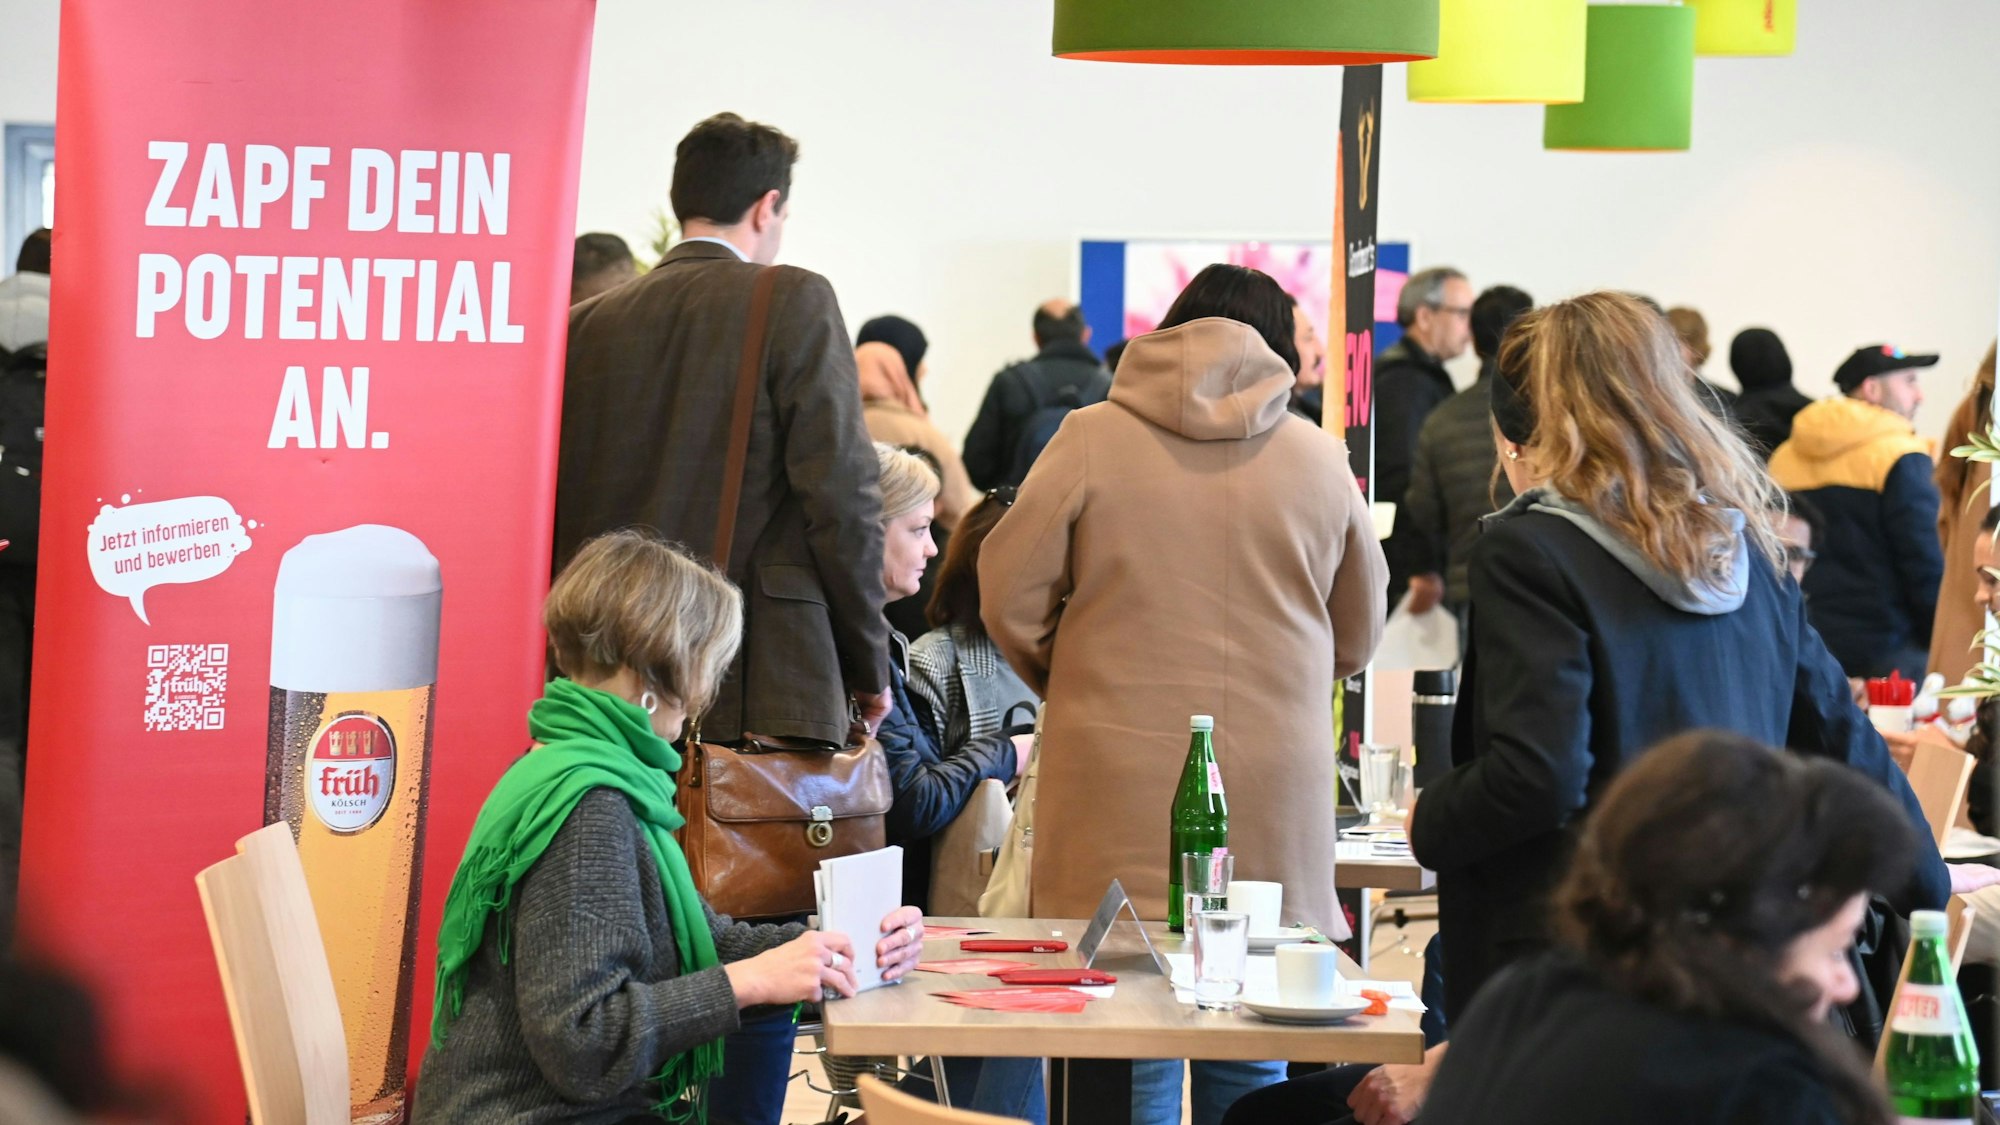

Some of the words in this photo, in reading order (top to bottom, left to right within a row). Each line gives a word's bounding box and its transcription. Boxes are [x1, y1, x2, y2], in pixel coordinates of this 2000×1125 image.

[145, 141, 331, 230] ZAPF
[348, 148, 511, 235] DEIN
[136, 253, 524, 343] POTENTIAL
[267, 366, 390, 448] AN.
[100, 530, 137, 551] Jetzt
[142, 516, 229, 545] informieren
[114, 553, 142, 574] und
[148, 542, 221, 568] bewerben
[170, 676, 203, 693] früh
[319, 765, 379, 799] früh
[331, 798, 366, 807] KÖLSCH
